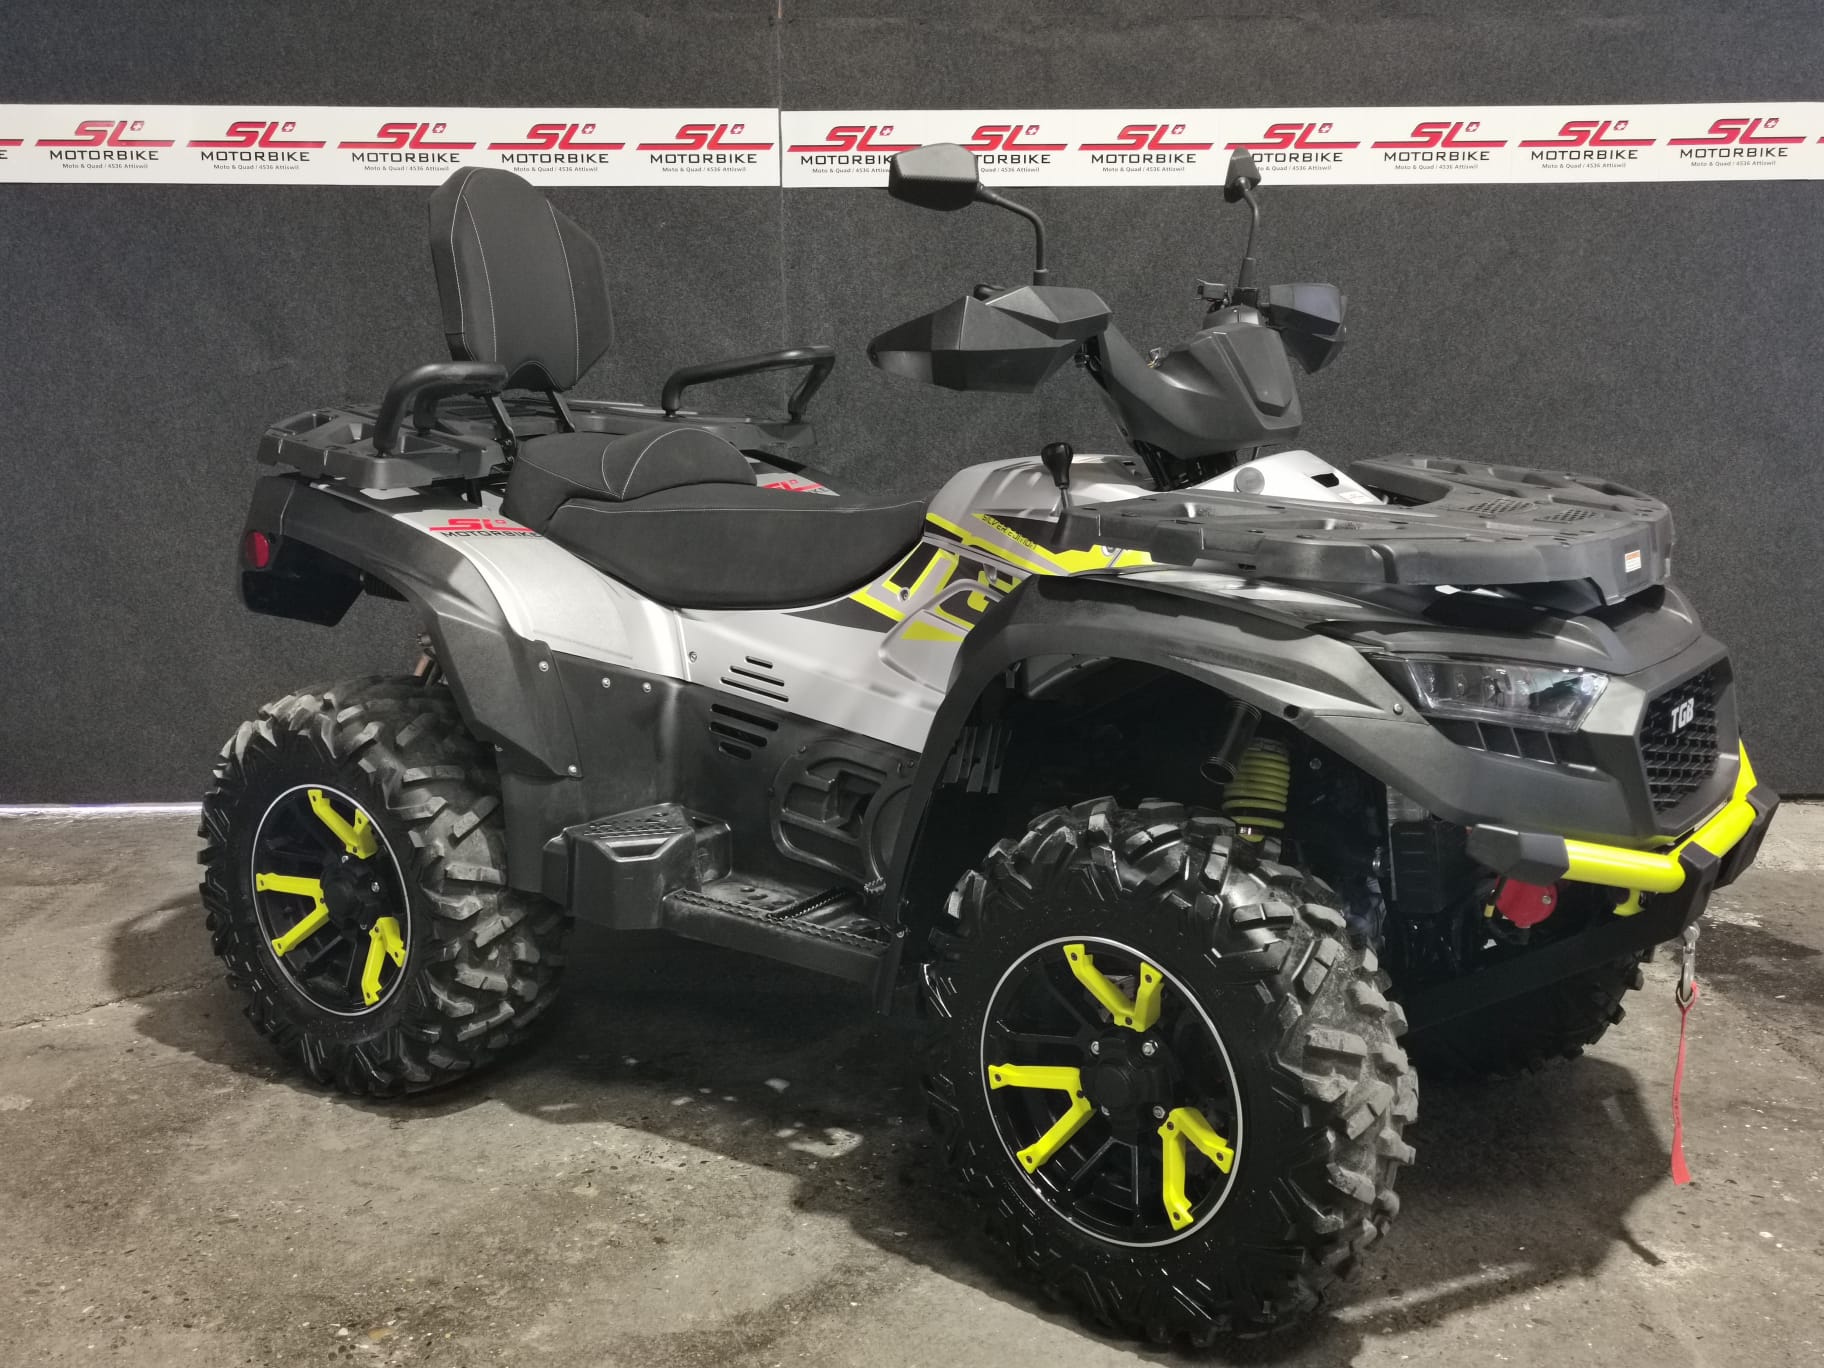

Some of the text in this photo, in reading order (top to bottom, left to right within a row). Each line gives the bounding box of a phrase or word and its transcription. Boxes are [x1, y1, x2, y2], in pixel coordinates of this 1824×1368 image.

[50, 151, 159, 160] MOTORBIKE
[201, 152, 310, 161] MOTORBIKE
[1384, 151, 1490, 162] MOTORBIKE
[1531, 150, 1638, 160] MOTORBIKE
[1680, 147, 1788, 158] MOTORBIKE
[352, 153, 460, 162] MOTORBIKE
[502, 154, 608, 163] MOTORBIKE
[651, 154, 757, 163] MOTORBIKE
[801, 155, 893, 165] MOTORBIK
[1092, 154, 1196, 163] MOTORBIKE
[1252, 153, 1343, 162] OTORBIKE
[1671, 697, 1695, 733] TGB
